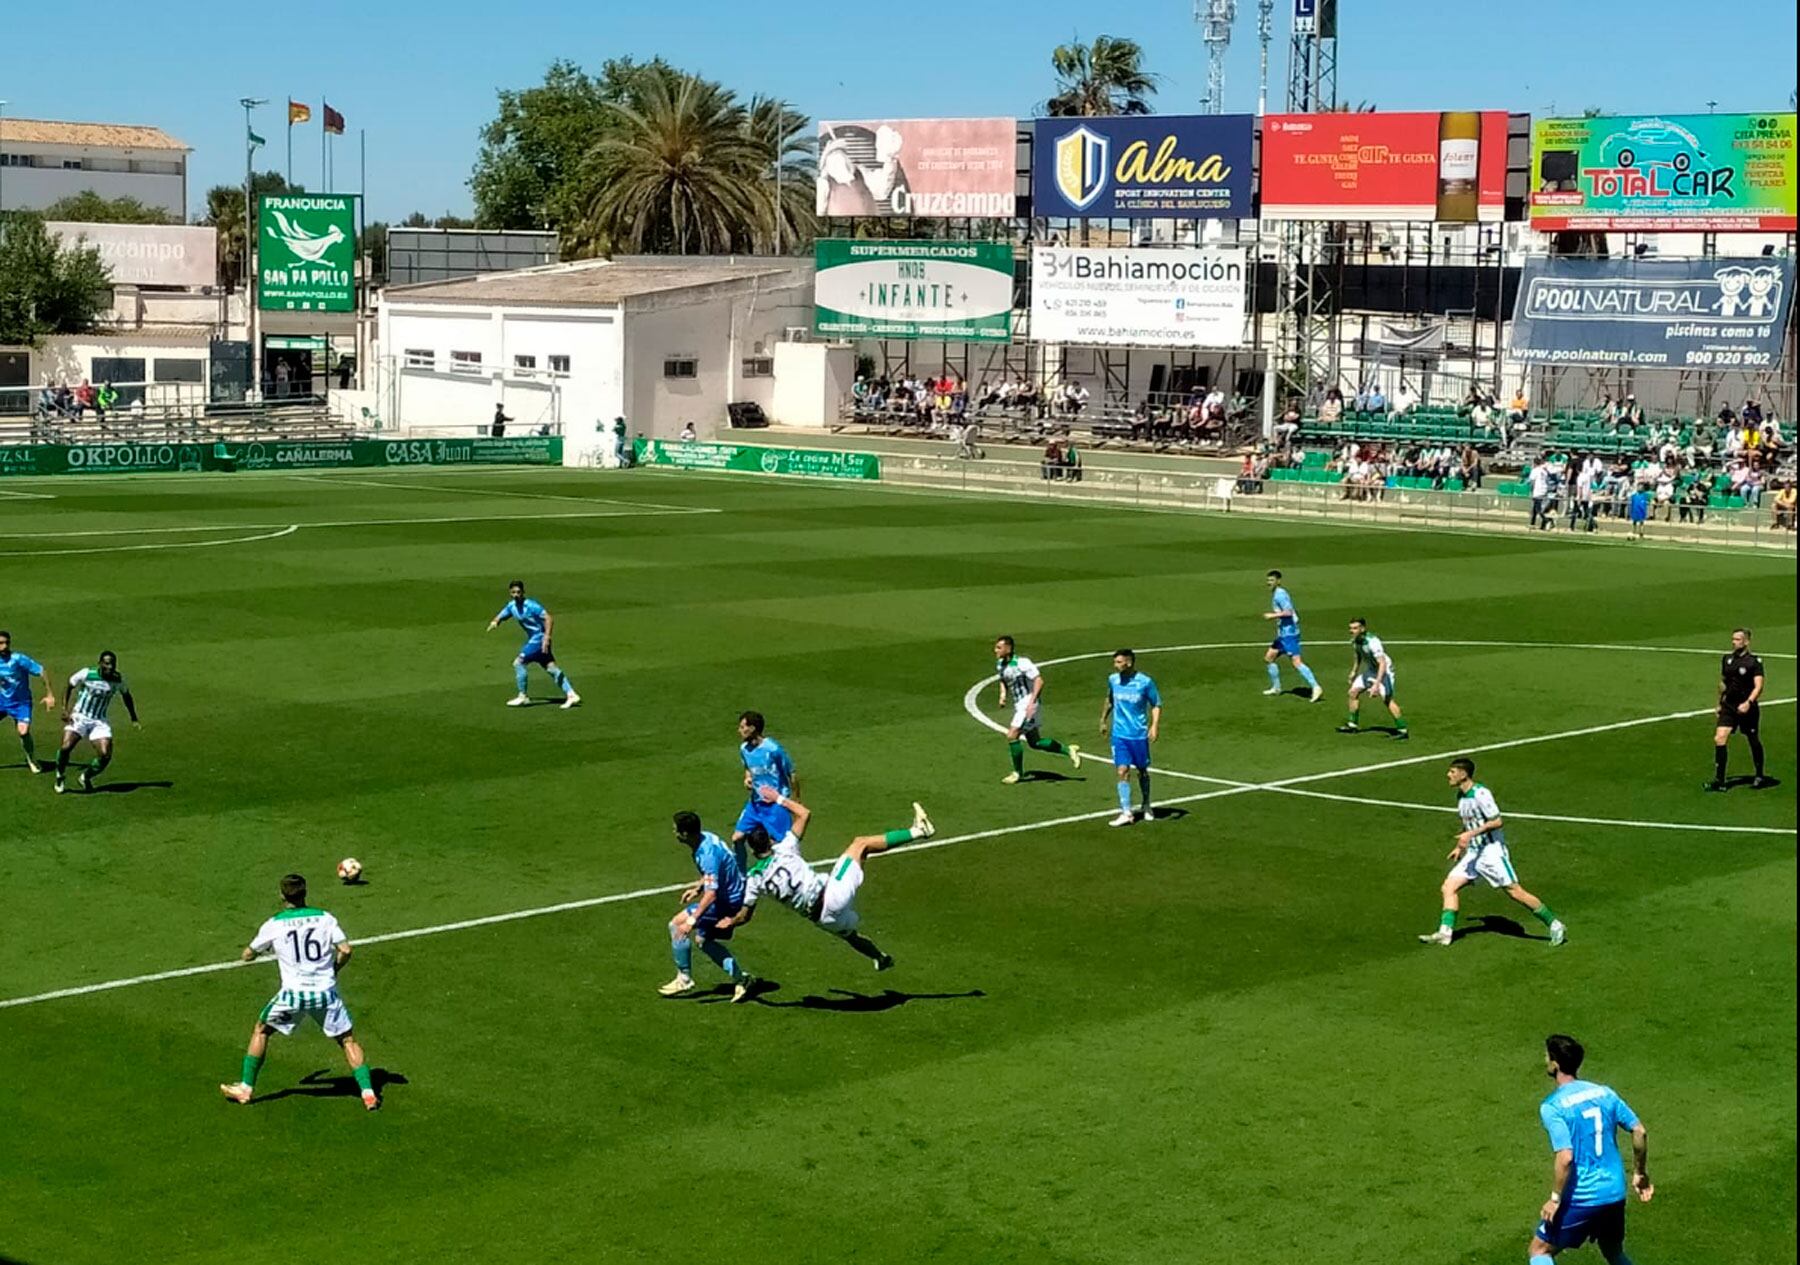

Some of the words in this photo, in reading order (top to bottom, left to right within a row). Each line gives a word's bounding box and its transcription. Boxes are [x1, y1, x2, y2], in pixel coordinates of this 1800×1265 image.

[1735, 130, 1754, 140] CITA
[1757, 129, 1791, 139] PREVIA
[1115, 135, 1231, 183] Alma
[1307, 154, 1339, 164] GUSTA
[1389, 154, 1401, 163] TE
[1402, 153, 1436, 164] GUSTA
[1672, 166, 1736, 199] CAR
[265, 197, 346, 211] FRANQUICIA
[891, 183, 1015, 215] Cruzcampo
[1115, 200, 1126, 209] LA
[850, 245, 977, 257] SUPERMERCADOS
[1075, 255, 1240, 281] Bahiamoción
[264, 269, 288, 286] SAN
[292, 270, 308, 286] PA
[311, 270, 348, 287] POLLO
[869, 282, 953, 308] INFANTE
[1534, 288, 1709, 313] POOLNATURAL
[1665, 323, 1717, 340] piscinas
[1721, 326, 1755, 338] como
[1510, 348, 1668, 363] www.poolnatural.com
[1685, 351, 1713, 364] 900
[1715, 351, 1742, 365] 920
[1744, 352, 1770, 365] 902
[68, 446, 173, 466] OKPOLLO
[276, 447, 354, 462] CAÑALERMA
[385, 442, 433, 463] CASA
[287, 928, 321, 963] 16
[1582, 1106, 1603, 1157] 7
